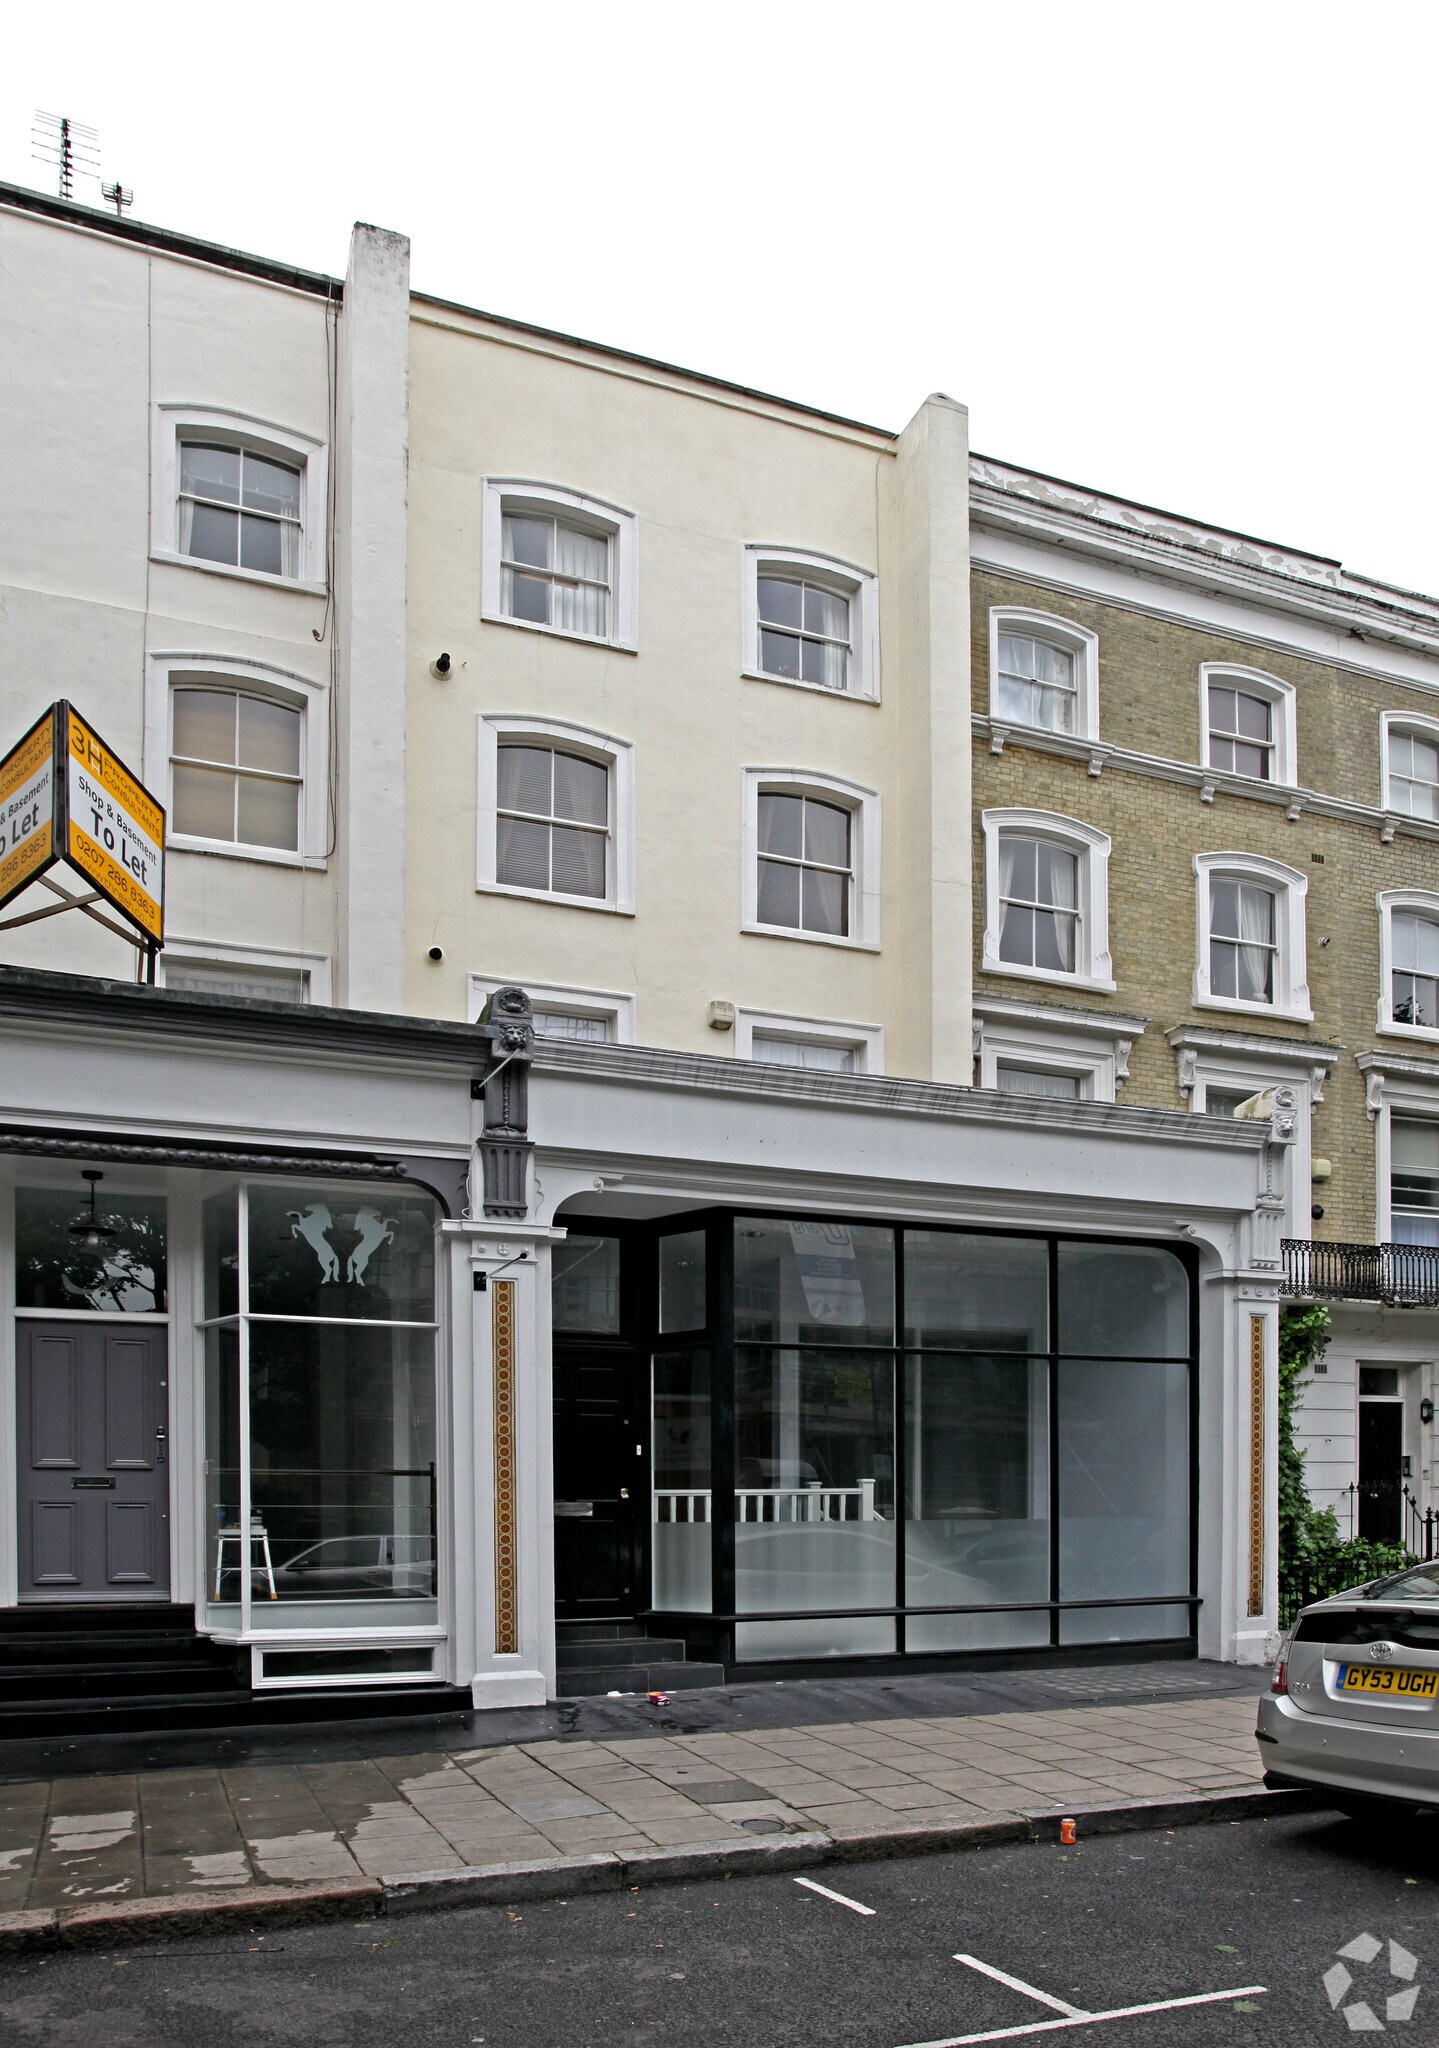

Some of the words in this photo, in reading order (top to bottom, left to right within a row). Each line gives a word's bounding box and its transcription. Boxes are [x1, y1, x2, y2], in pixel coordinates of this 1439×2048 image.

[0, 737, 52, 795] CONSULTANTS
[1, 723, 51, 780] PROPERTY
[8, 772, 49, 818] Basement
[104, 758, 160, 824] PROPERTY
[104, 771, 161, 839] CONSULTANTS
[12, 802, 39, 845] Let
[78, 776, 104, 810] Shop
[107, 803, 114, 820] &
[117, 814, 157, 866] Basement
[90, 806, 114, 850] To
[121, 841, 147, 886] Let
[1, 856, 18, 882] 286
[21, 832, 46, 864] 8363
[76, 834, 105, 869] 0207
[108, 864, 128, 893] 286
[130, 886, 155, 920] 8363
[1347, 1668, 1394, 1689] GY53
[1397, 1672, 1437, 1694] UGH
